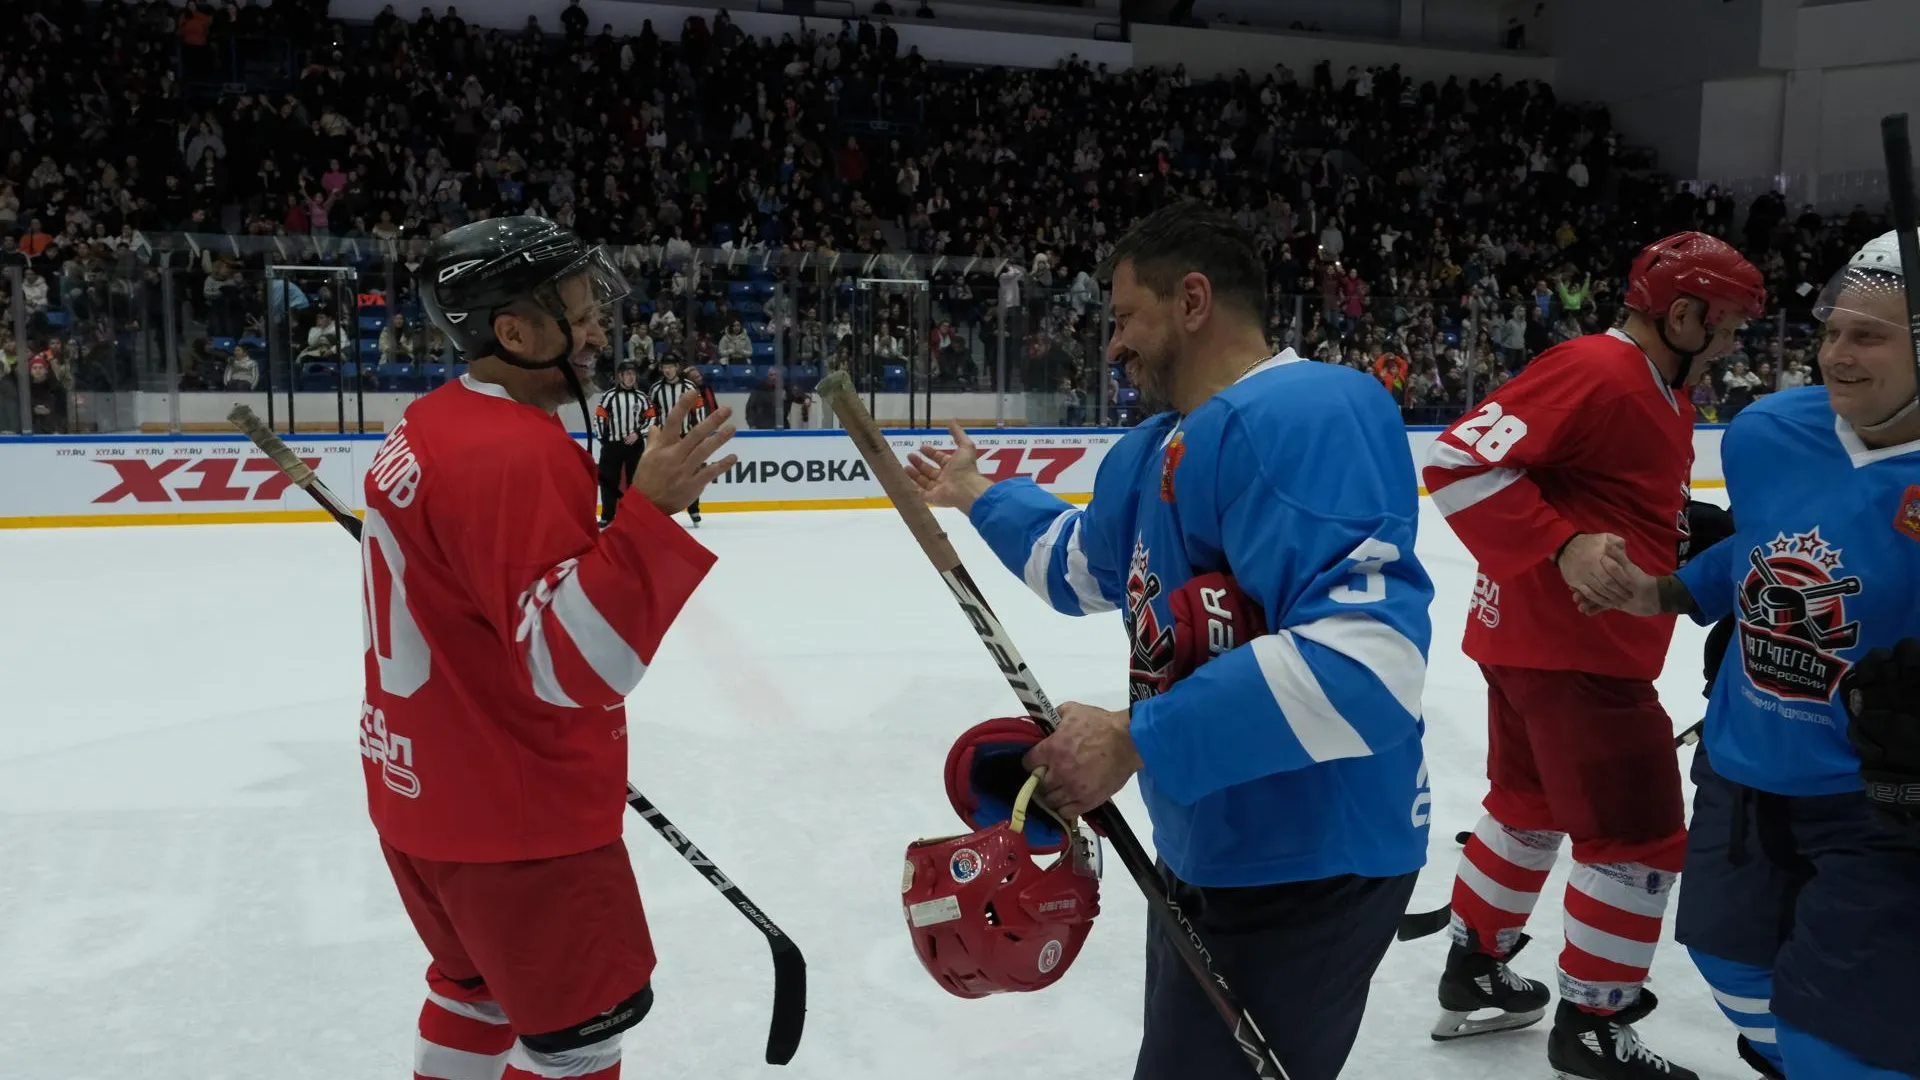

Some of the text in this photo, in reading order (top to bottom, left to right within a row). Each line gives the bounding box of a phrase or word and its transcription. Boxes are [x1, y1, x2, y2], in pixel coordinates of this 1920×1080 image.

[1451, 401, 1527, 462] 28
[90, 457, 322, 503] X17
[703, 459, 870, 485] ПИРОВКА
[942, 447, 1087, 485] 17
[1200, 587, 1234, 655] ER
[1035, 688, 1062, 727] KORNE
[1166, 891, 1213, 972] VAPOR
